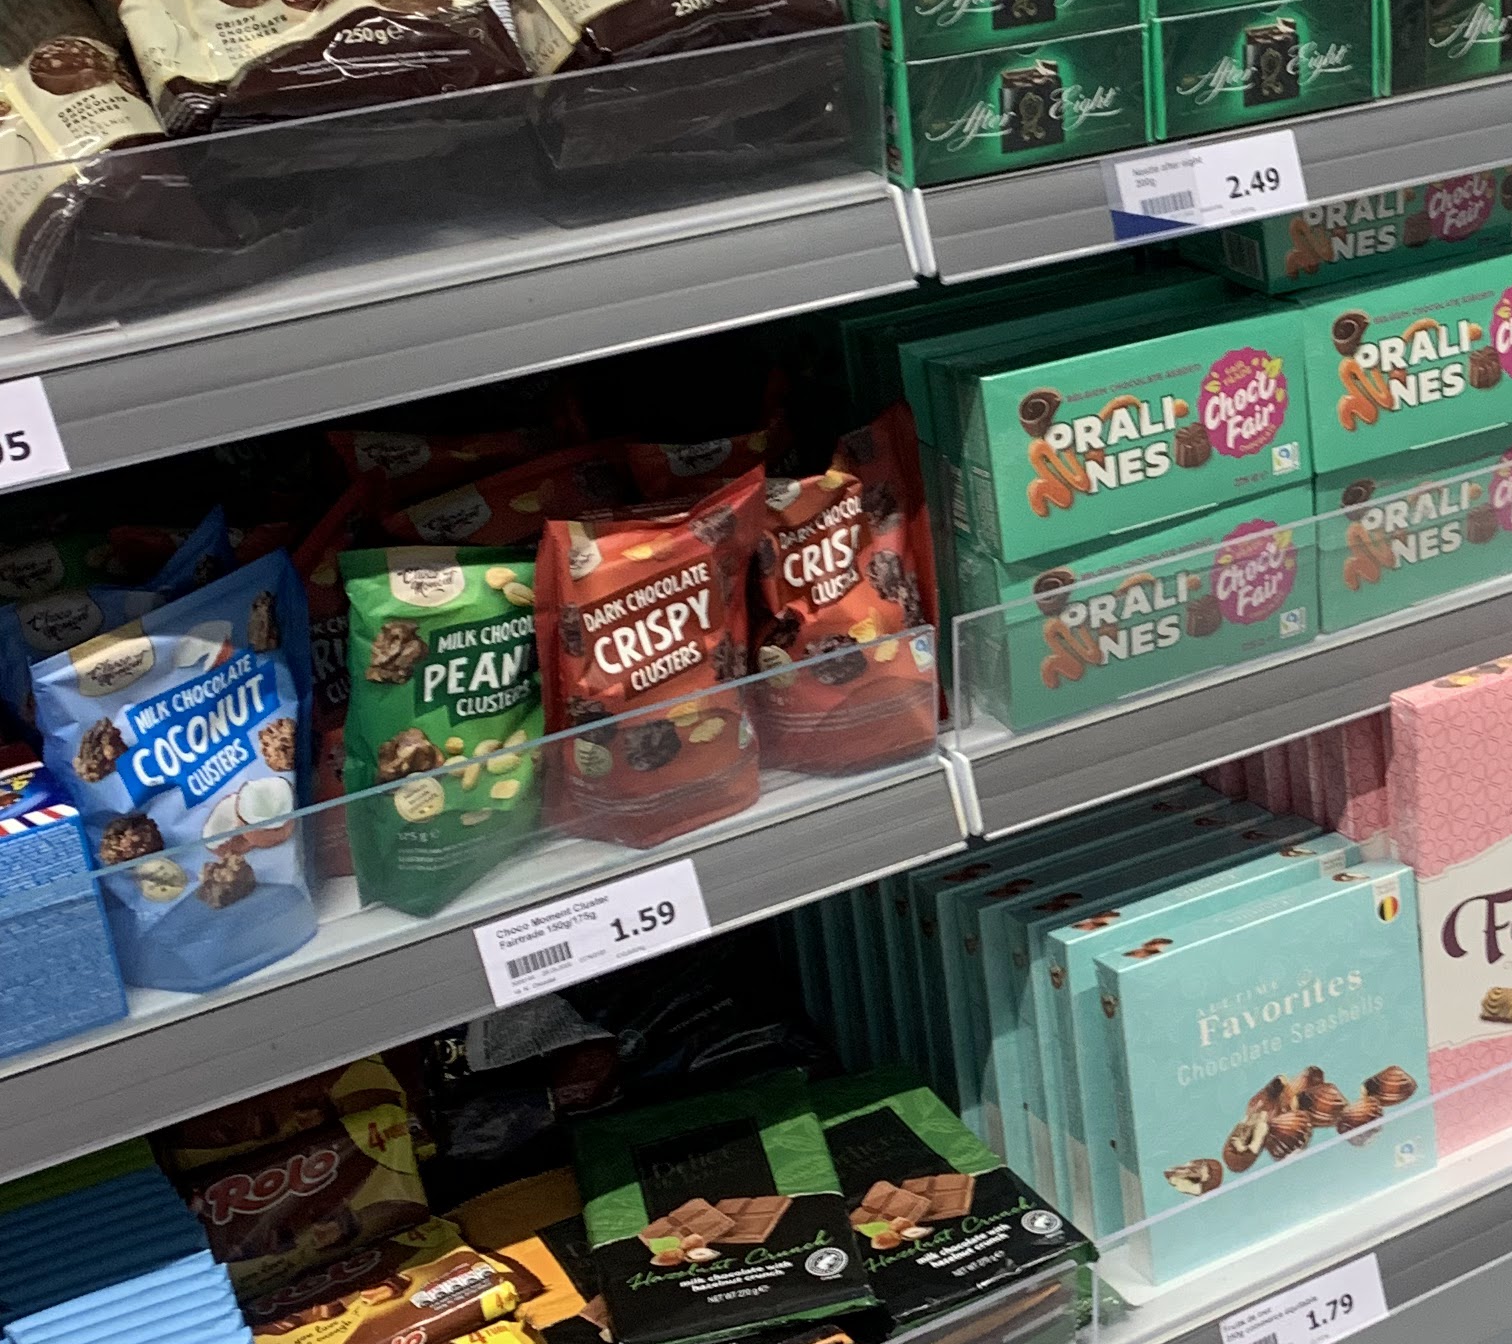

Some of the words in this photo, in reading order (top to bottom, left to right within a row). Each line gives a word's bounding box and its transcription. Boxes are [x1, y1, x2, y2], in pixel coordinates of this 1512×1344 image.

[1226, 167, 1281, 199] 2.49
[1330, 224, 1398, 264] NES
[1388, 362, 1466, 412] NES
[0, 430, 31, 462] 5
[1225, 402, 1276, 450] Fair
[1084, 440, 1172, 494] NES
[1390, 523, 1464, 569] NES
[583, 599, 628, 632] DARK
[627, 562, 711, 609] CHOCOLATE
[437, 629, 477, 654] MILK
[594, 590, 711, 675] CRISPY
[1099, 615, 1181, 666] NES
[631, 641, 701, 692] CLUSTERS
[134, 699, 171, 734] MILK
[172, 654, 253, 713] CHOCOLATE
[132, 673, 265, 787] COCONUT
[186, 738, 250, 796] CLUSTERS
[496, 919, 529, 938] Choco
[531, 906, 569, 930] Moment
[609, 902, 676, 941] 1.59
[1196, 969, 1363, 1047] Favorites
[1177, 1032, 1283, 1086] Chocolate
[1290, 993, 1384, 1046] Seashells
[680, 1278, 701, 1289] milk
[701, 1267, 763, 1286] chocolate
[765, 1260, 794, 1275] with
[691, 1276, 744, 1292] hazelnut
[745, 1269, 786, 1284] crunch
[1306, 1293, 1354, 1331] 1.79
